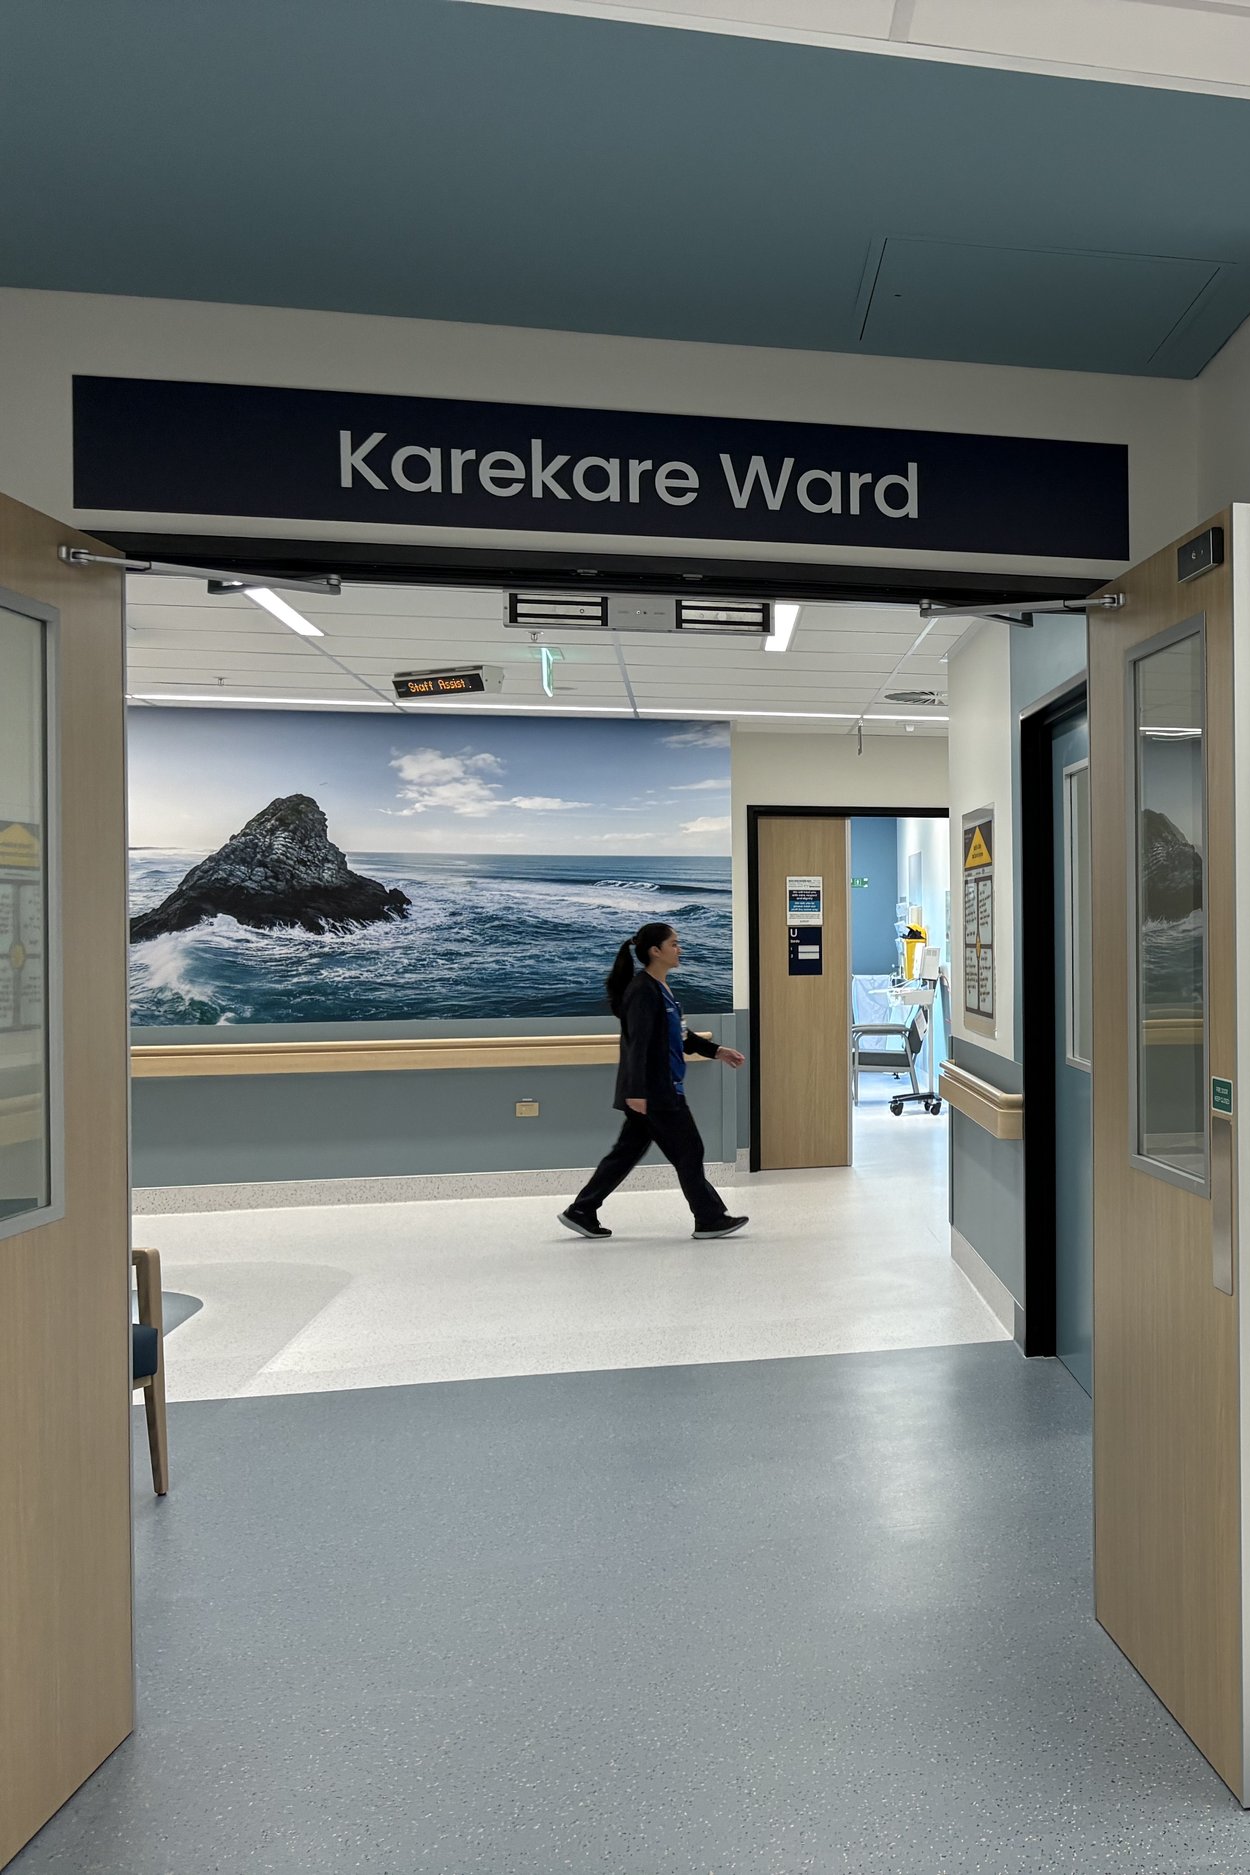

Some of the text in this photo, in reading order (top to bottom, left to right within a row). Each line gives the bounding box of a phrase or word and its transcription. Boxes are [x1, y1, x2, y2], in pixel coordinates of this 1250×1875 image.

[339, 430, 919, 518] Karekare Ward
[408, 682, 434, 692] Staff
